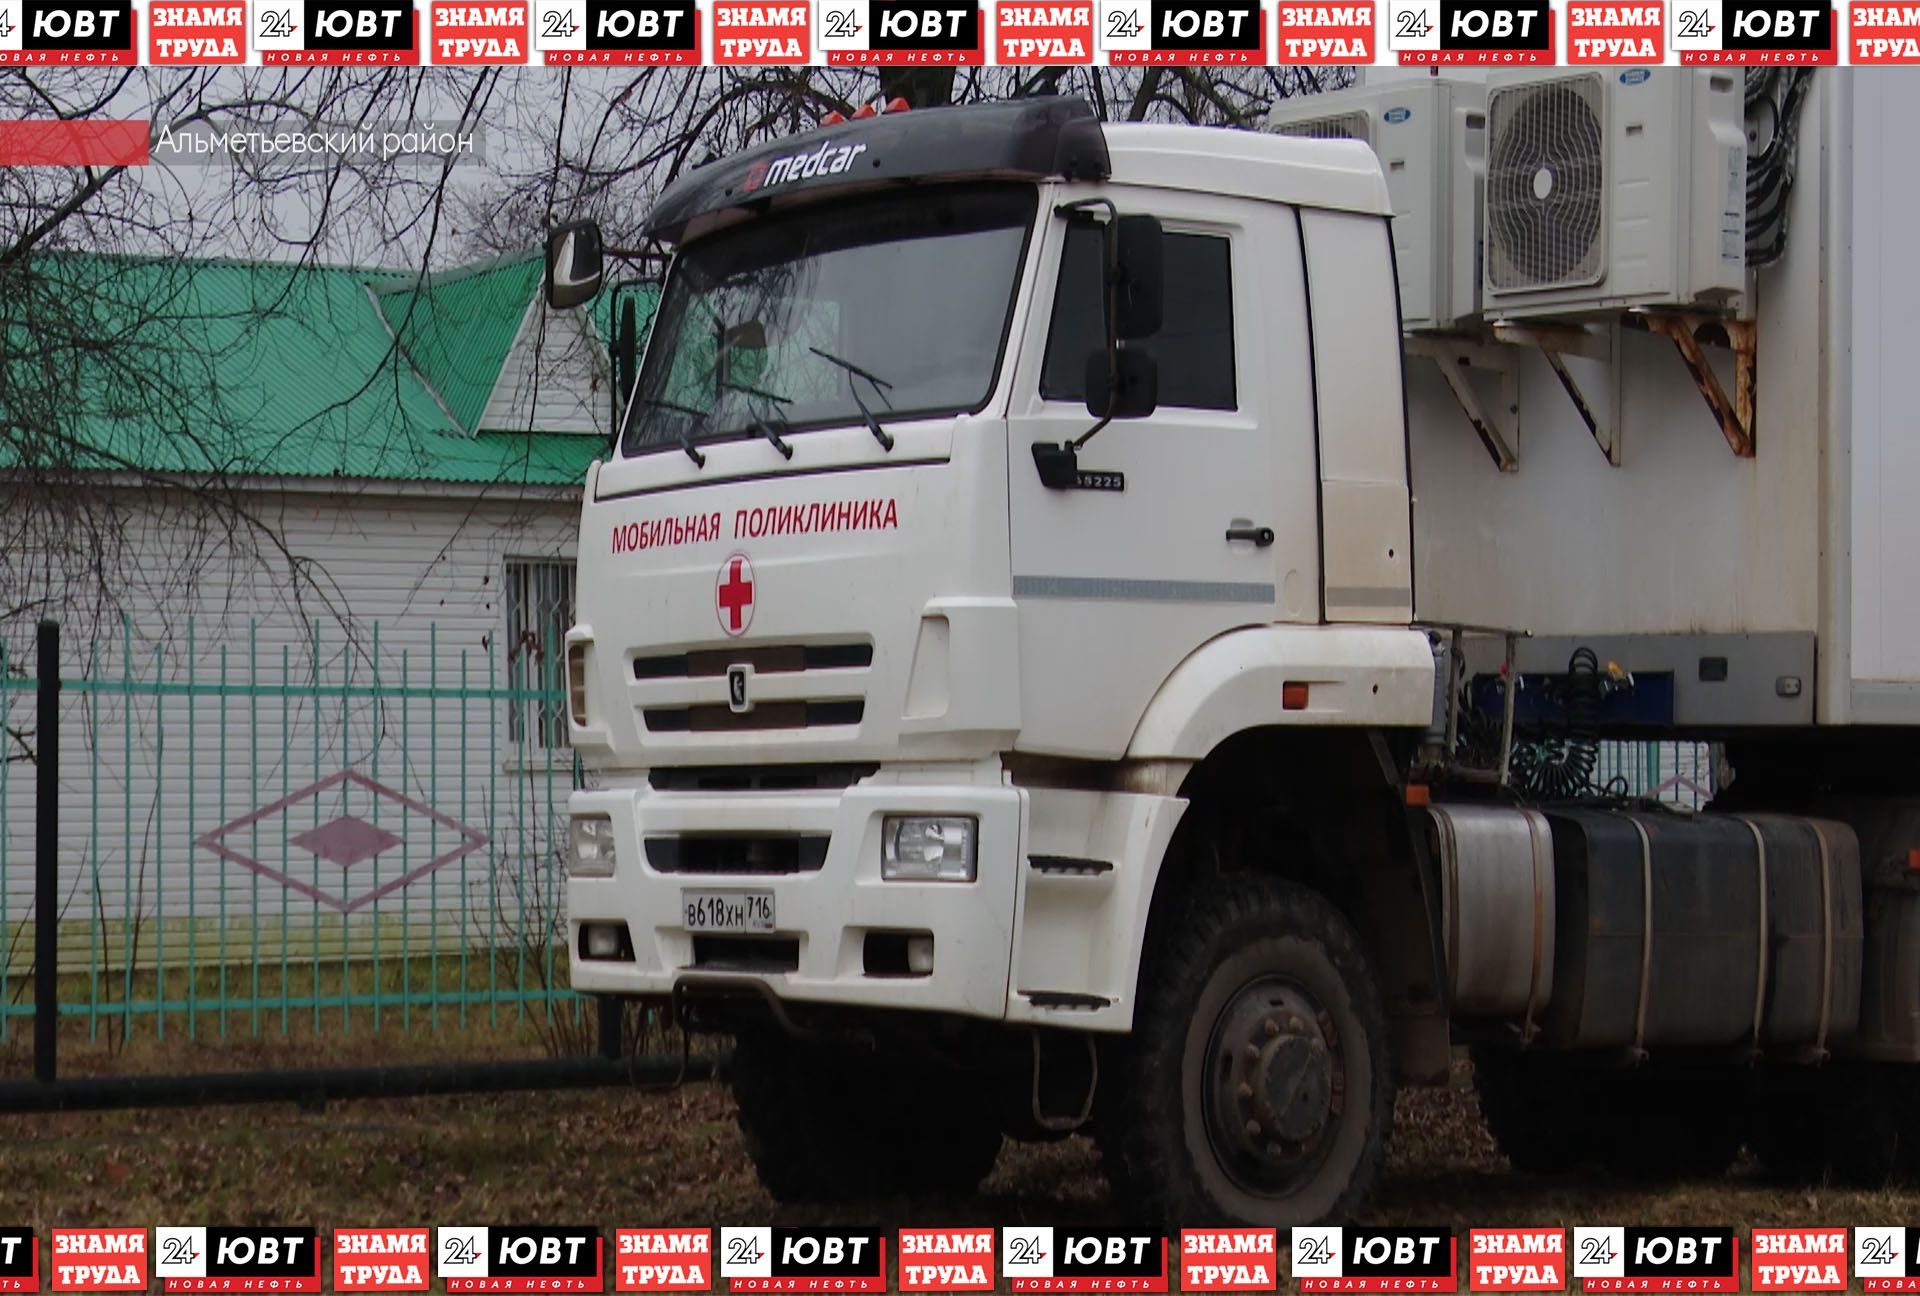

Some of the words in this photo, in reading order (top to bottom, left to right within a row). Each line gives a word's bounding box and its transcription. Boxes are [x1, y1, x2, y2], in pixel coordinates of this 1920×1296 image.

[762, 140, 867, 188] medcar
[611, 511, 721, 554] МОБИЛЬНАЯ
[733, 498, 899, 540] ПОЛИКЛИНИКА
[747, 896, 770, 919] 716
